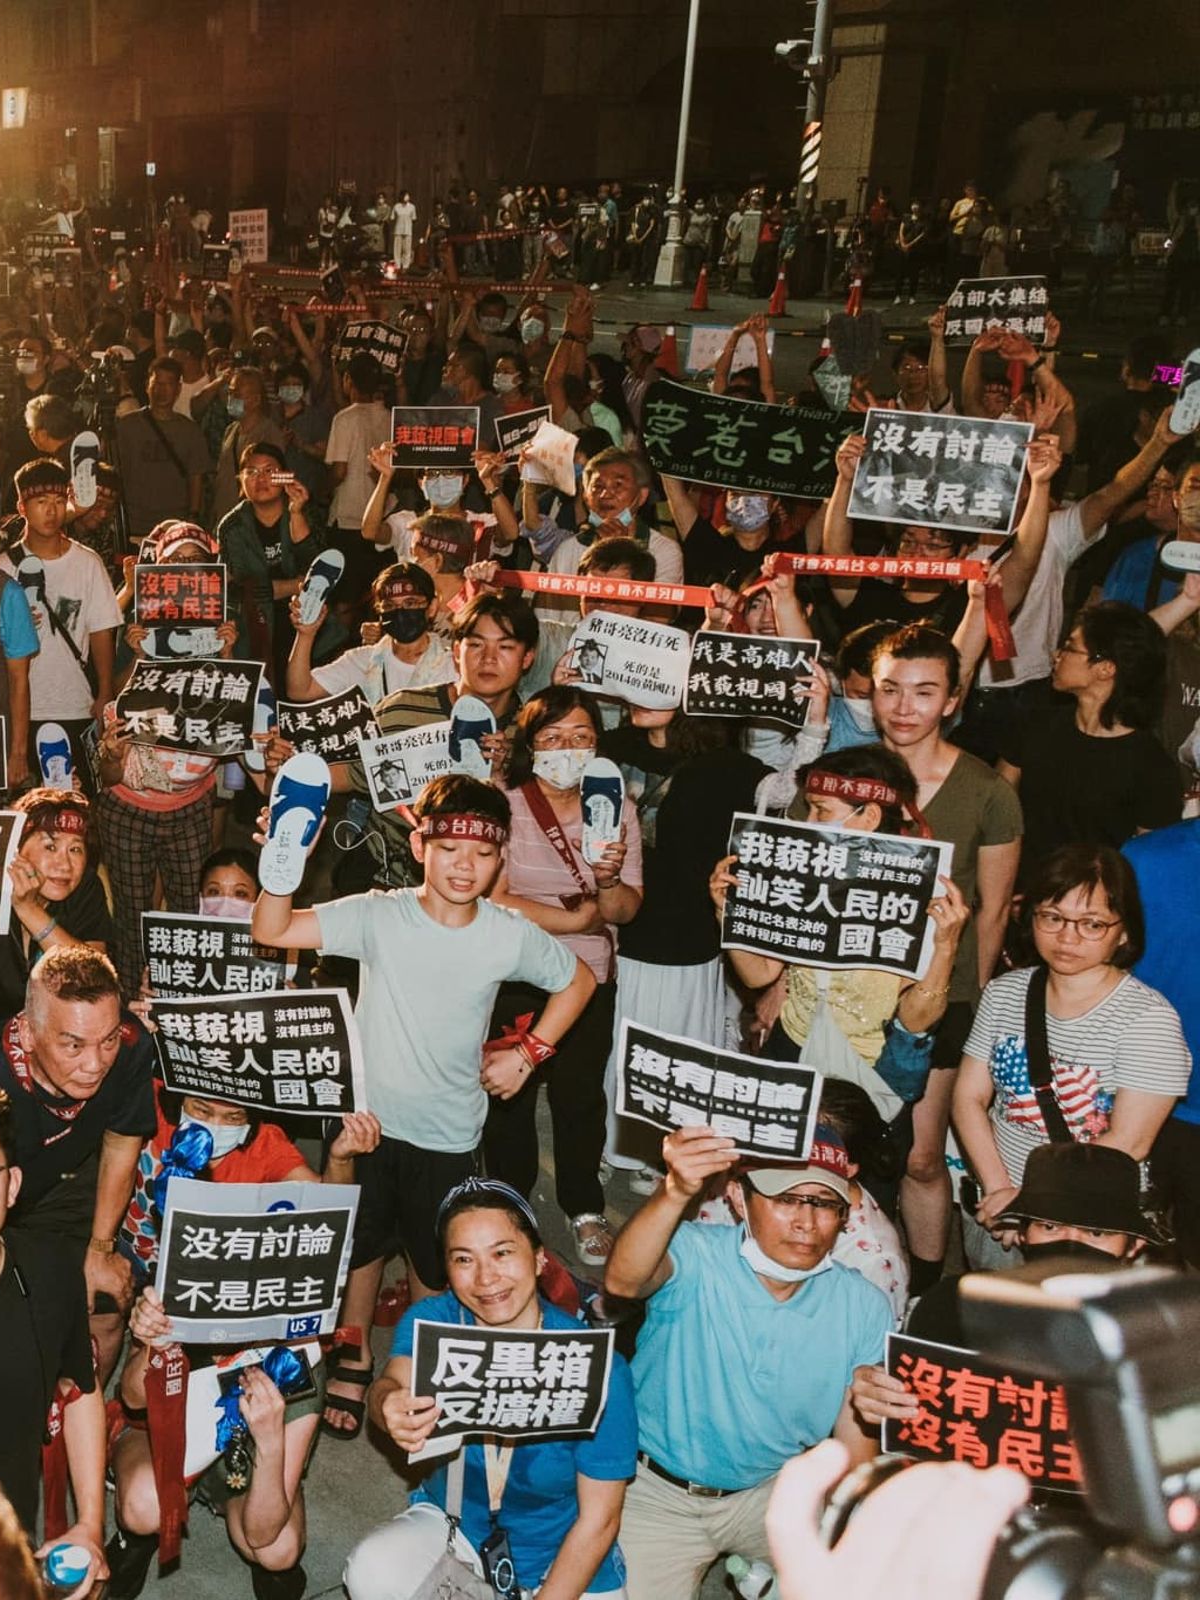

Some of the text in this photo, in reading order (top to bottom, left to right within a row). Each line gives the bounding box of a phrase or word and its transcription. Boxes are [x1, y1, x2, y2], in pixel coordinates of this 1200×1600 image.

[947, 287, 1048, 308] 南部大集結
[872, 422, 1020, 467] 沒有討論
[861, 475, 1003, 519] 不是民主
[141, 572, 221, 595] 沒有討論
[140, 597, 222, 620] 沒有民主
[588, 618, 681, 652] 豬哥亮沒有死
[624, 660, 662, 680] 死的是
[694, 640, 813, 673] 我是高雄人
[132, 669, 252, 704] 沒有討論
[688, 672, 812, 705] 我藐視國會
[124, 709, 245, 746] 不是民主
[279, 694, 370, 733] 我是高雄人
[291, 719, 379, 754] 藐視國會
[737, 832, 849, 880] 我藐視
[859, 850, 924, 870] 沒有討論的
[857, 865, 922, 886] 沒有民主的
[735, 869, 919, 925] 訕笑人民的
[734, 904, 828, 936] 沒有記名表決的
[148, 927, 225, 958] 我藐視
[731, 921, 826, 953] 沒有程序正義的
[837, 923, 916, 962] 國會
[149, 957, 278, 993] 訕笑人民的
[157, 1011, 268, 1044] 我藐視
[274, 1007, 332, 1022] 沒有討論的
[275, 1022, 335, 1038] 沒有民主的
[165, 1039, 341, 1076] 訕笑人民的
[273, 1078, 346, 1107] 國會
[628, 1043, 808, 1111] 沒有討論
[174, 1276, 325, 1312] 不是民主
[290, 1320, 307, 1334] US
[430, 1338, 594, 1389] 反黑箱
[435, 1390, 588, 1429] 反擴權
